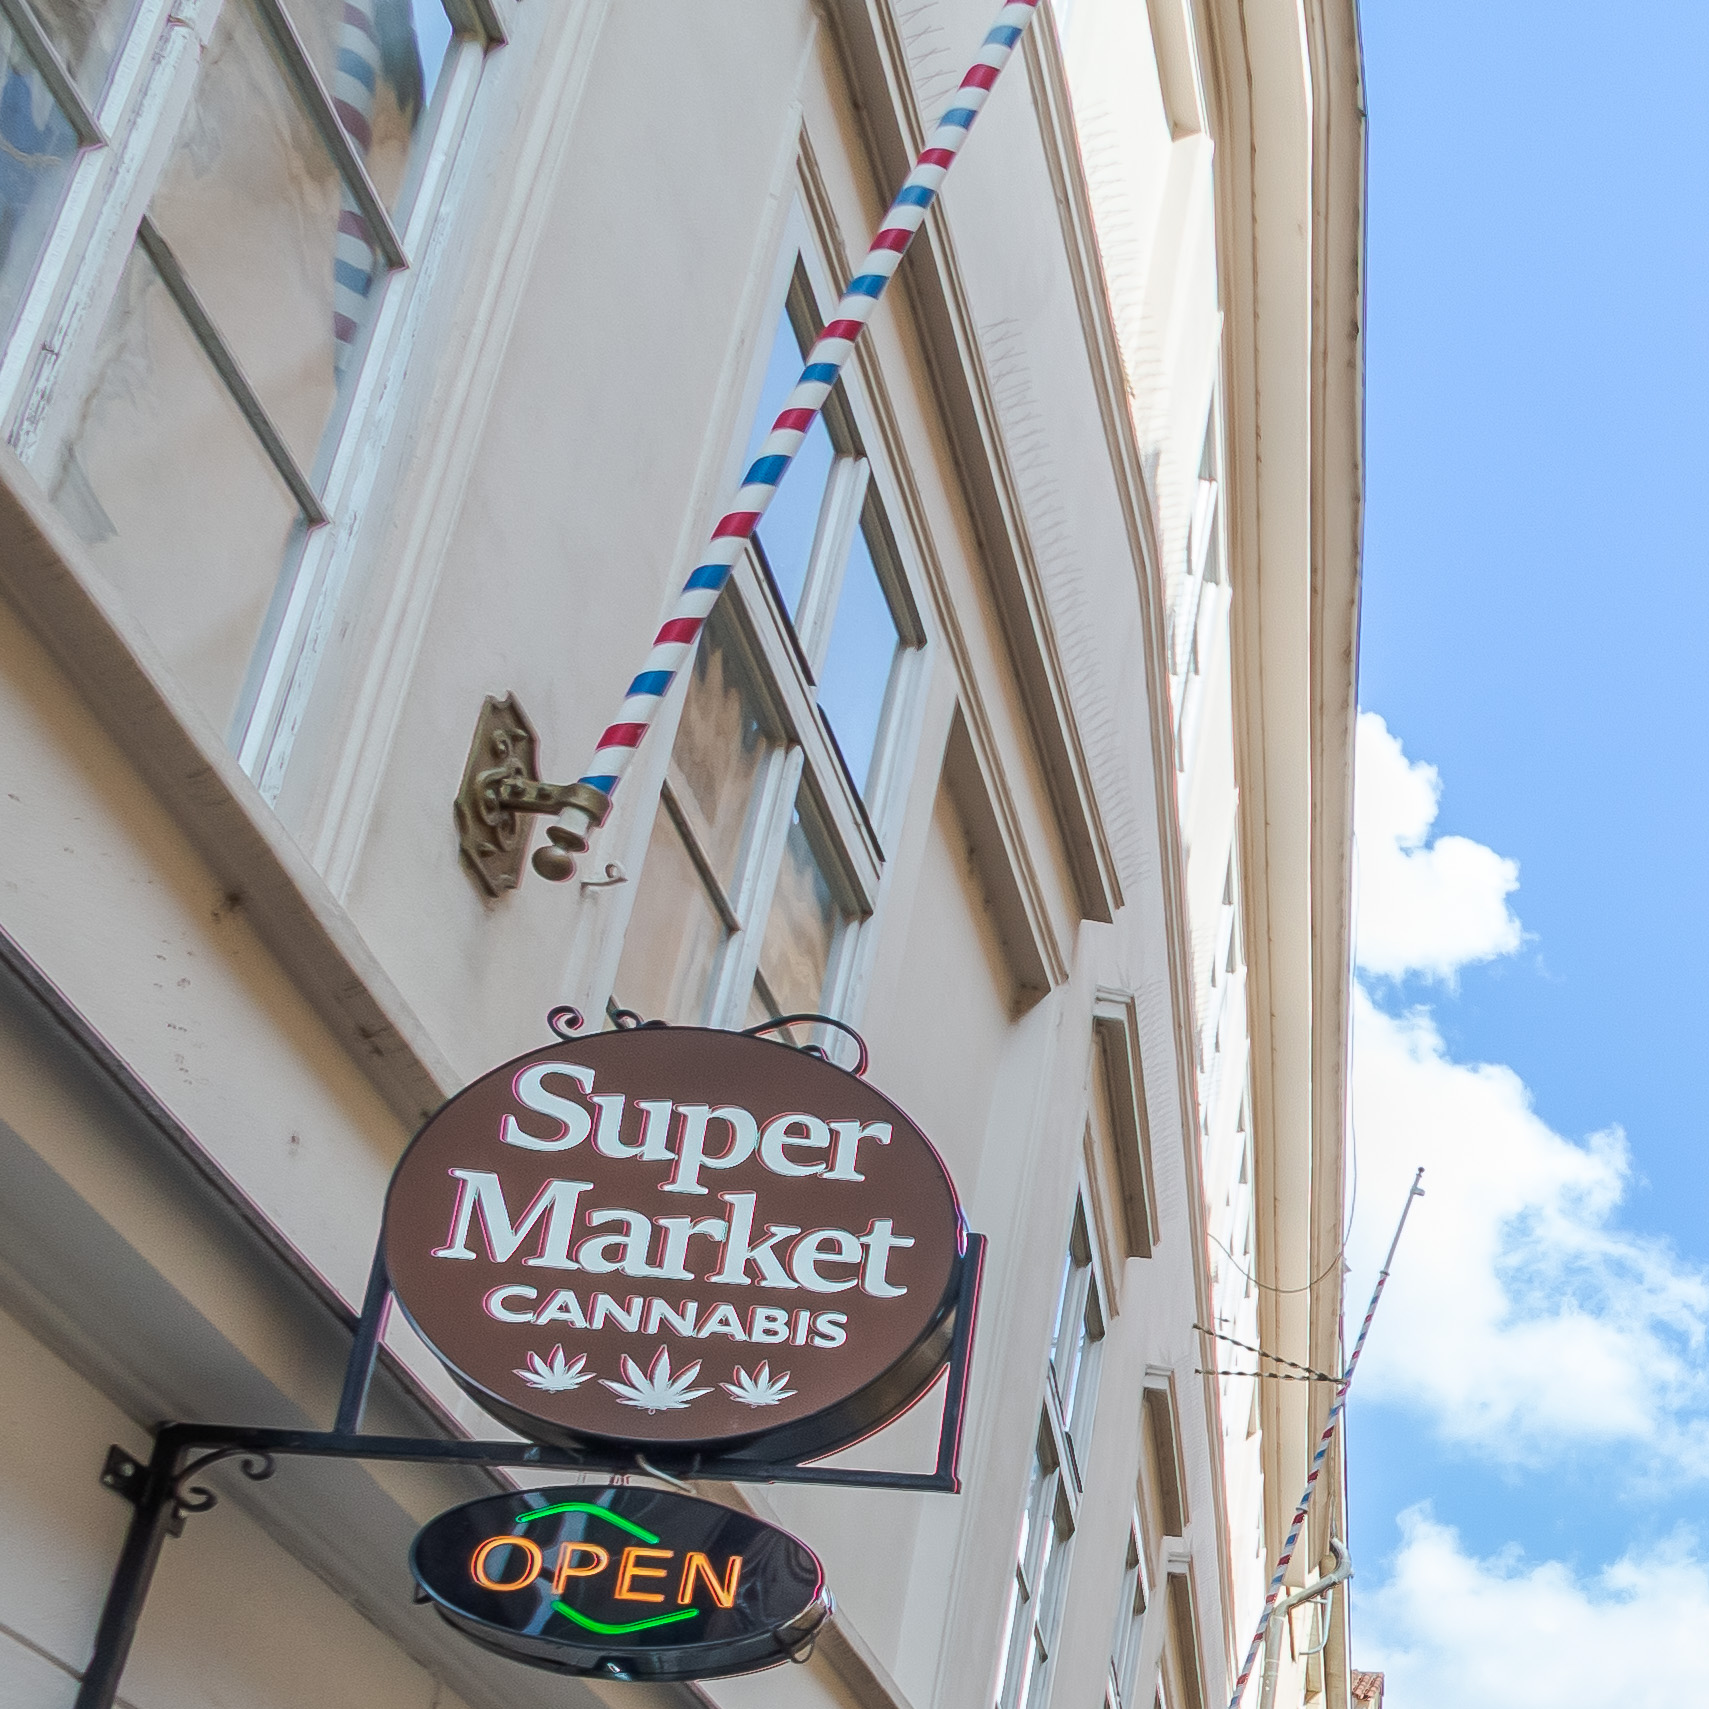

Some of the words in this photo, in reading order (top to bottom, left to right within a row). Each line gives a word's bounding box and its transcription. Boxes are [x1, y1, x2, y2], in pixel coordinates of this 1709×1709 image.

[500, 1060, 892, 1196] Super
[432, 1167, 916, 1299] Market
[486, 1284, 848, 1349] CANNABIS
[470, 1535, 743, 1609] OPEN
